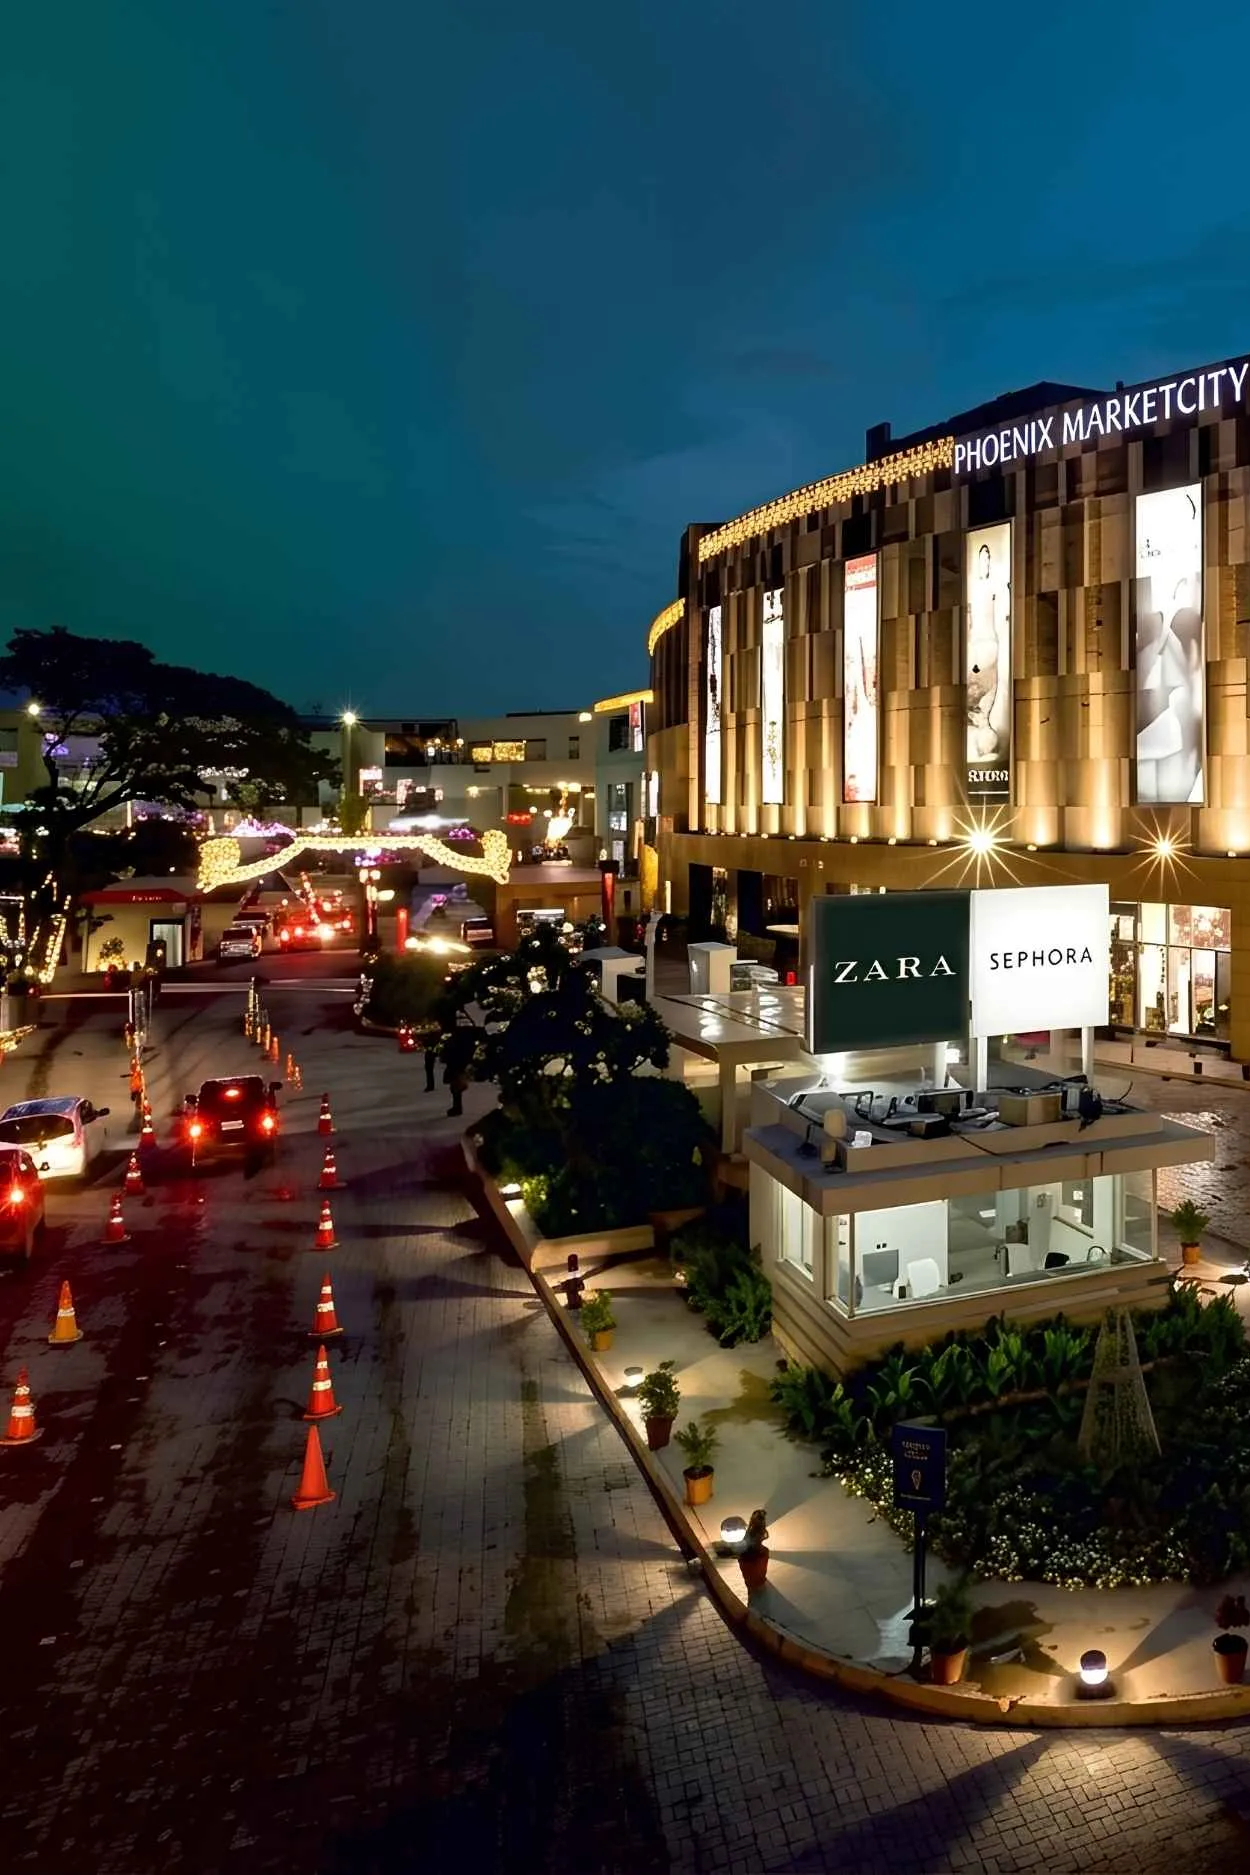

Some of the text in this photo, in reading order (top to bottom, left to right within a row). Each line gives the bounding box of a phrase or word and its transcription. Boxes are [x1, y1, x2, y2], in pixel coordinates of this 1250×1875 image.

[954, 363, 1250, 475] PHOENIX MARKETCITY
[833, 955, 958, 984] ZARA
[989, 947, 1093, 971] SEPHORA
